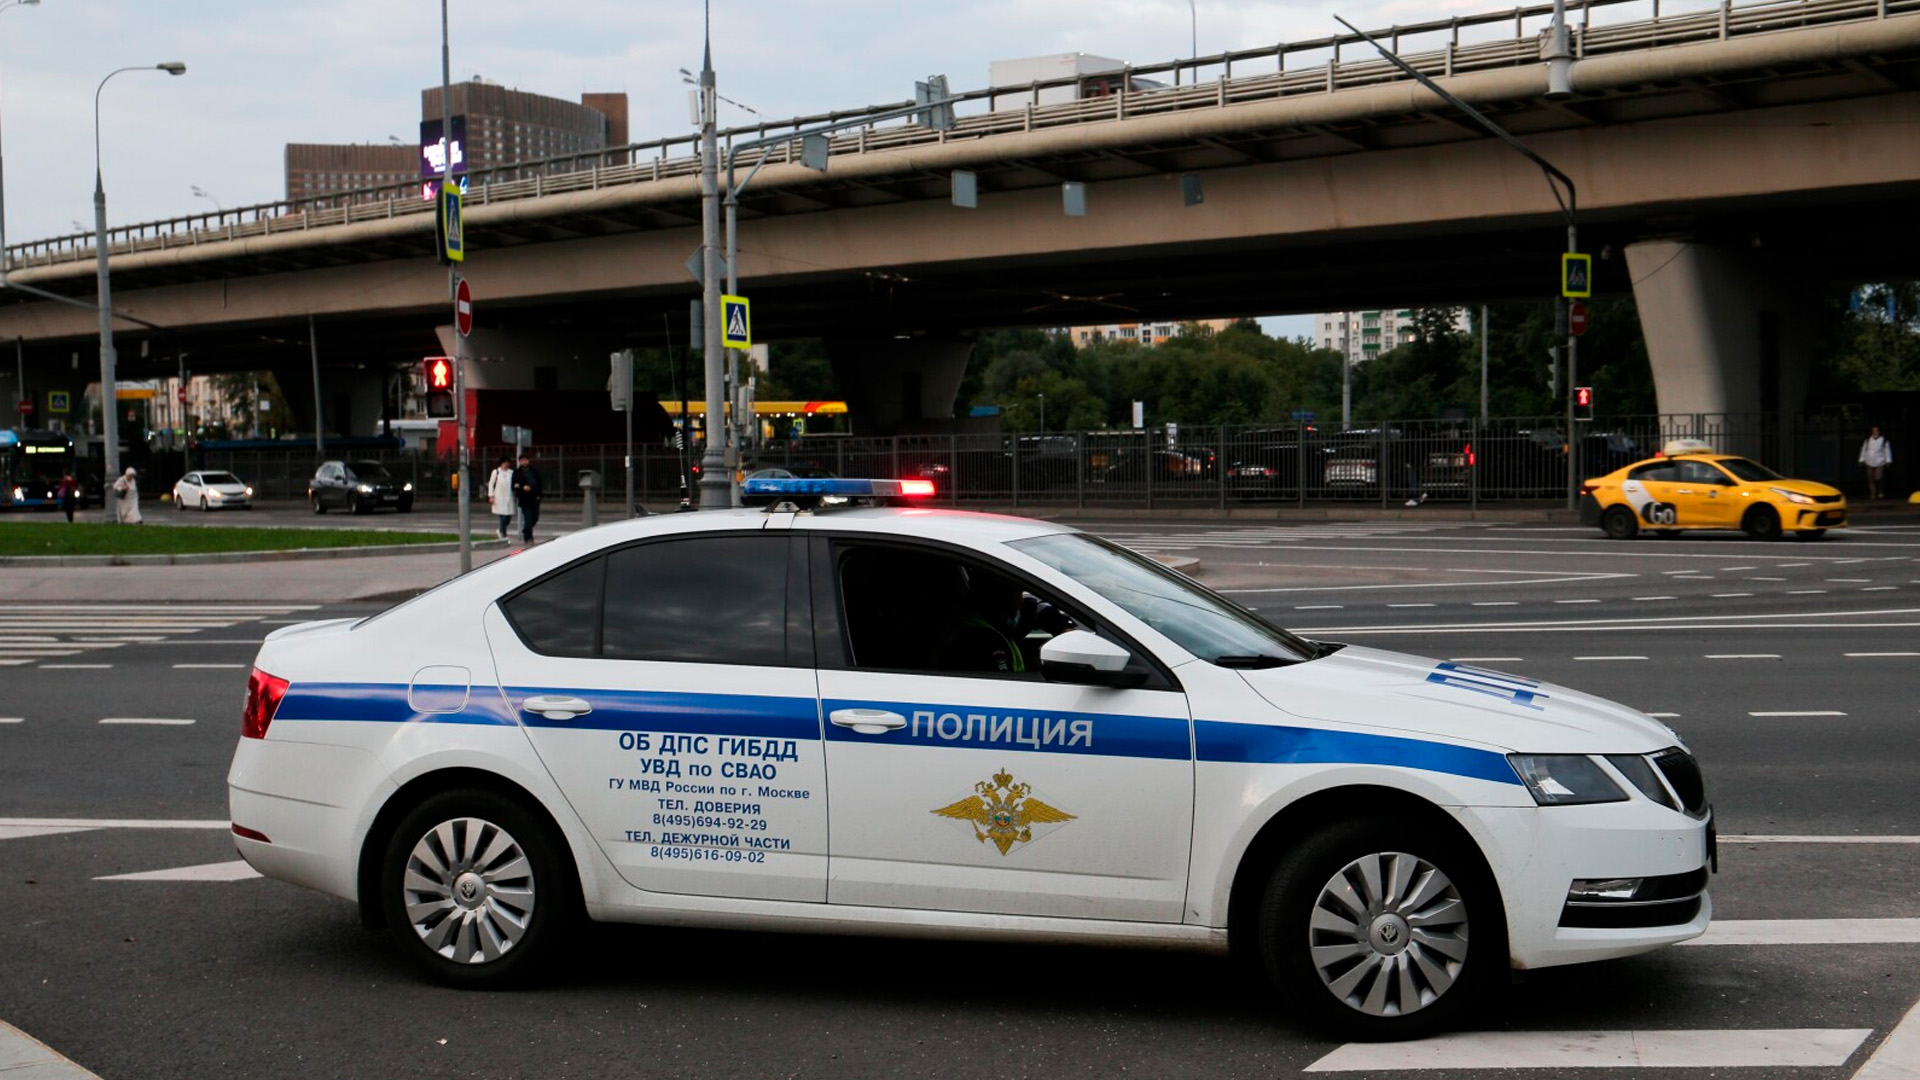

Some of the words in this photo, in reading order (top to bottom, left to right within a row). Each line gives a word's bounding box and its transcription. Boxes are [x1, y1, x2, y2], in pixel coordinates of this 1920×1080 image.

[911, 710, 1094, 750] ПОЛИЦИЯ
[618, 732, 651, 751] ОБ
[658, 735, 709, 756] ДПС
[718, 737, 799, 762] ГИБДД
[641, 758, 681, 778] УВД
[688, 764, 713, 778] по
[721, 762, 777, 780] СВАО
[609, 778, 625, 789] ГУ
[629, 779, 661, 793] МВД
[665, 781, 715, 795] России
[720, 786, 736, 796] по
[741, 787, 752, 797] г.
[758, 786, 810, 799] Москве
[658, 799, 689, 811] ТЕЛ.
[694, 801, 761, 815] ДОВЕРИЯ
[652, 813, 768, 831] 8(495)694-92-29
[625, 831, 656, 843] ТЕЛ.
[661, 832, 739, 848] ДЕЖУРНОЙ
[744, 836, 790, 850] ЧАСТИ
[650, 846, 765, 864] 8(495)616-09-02
